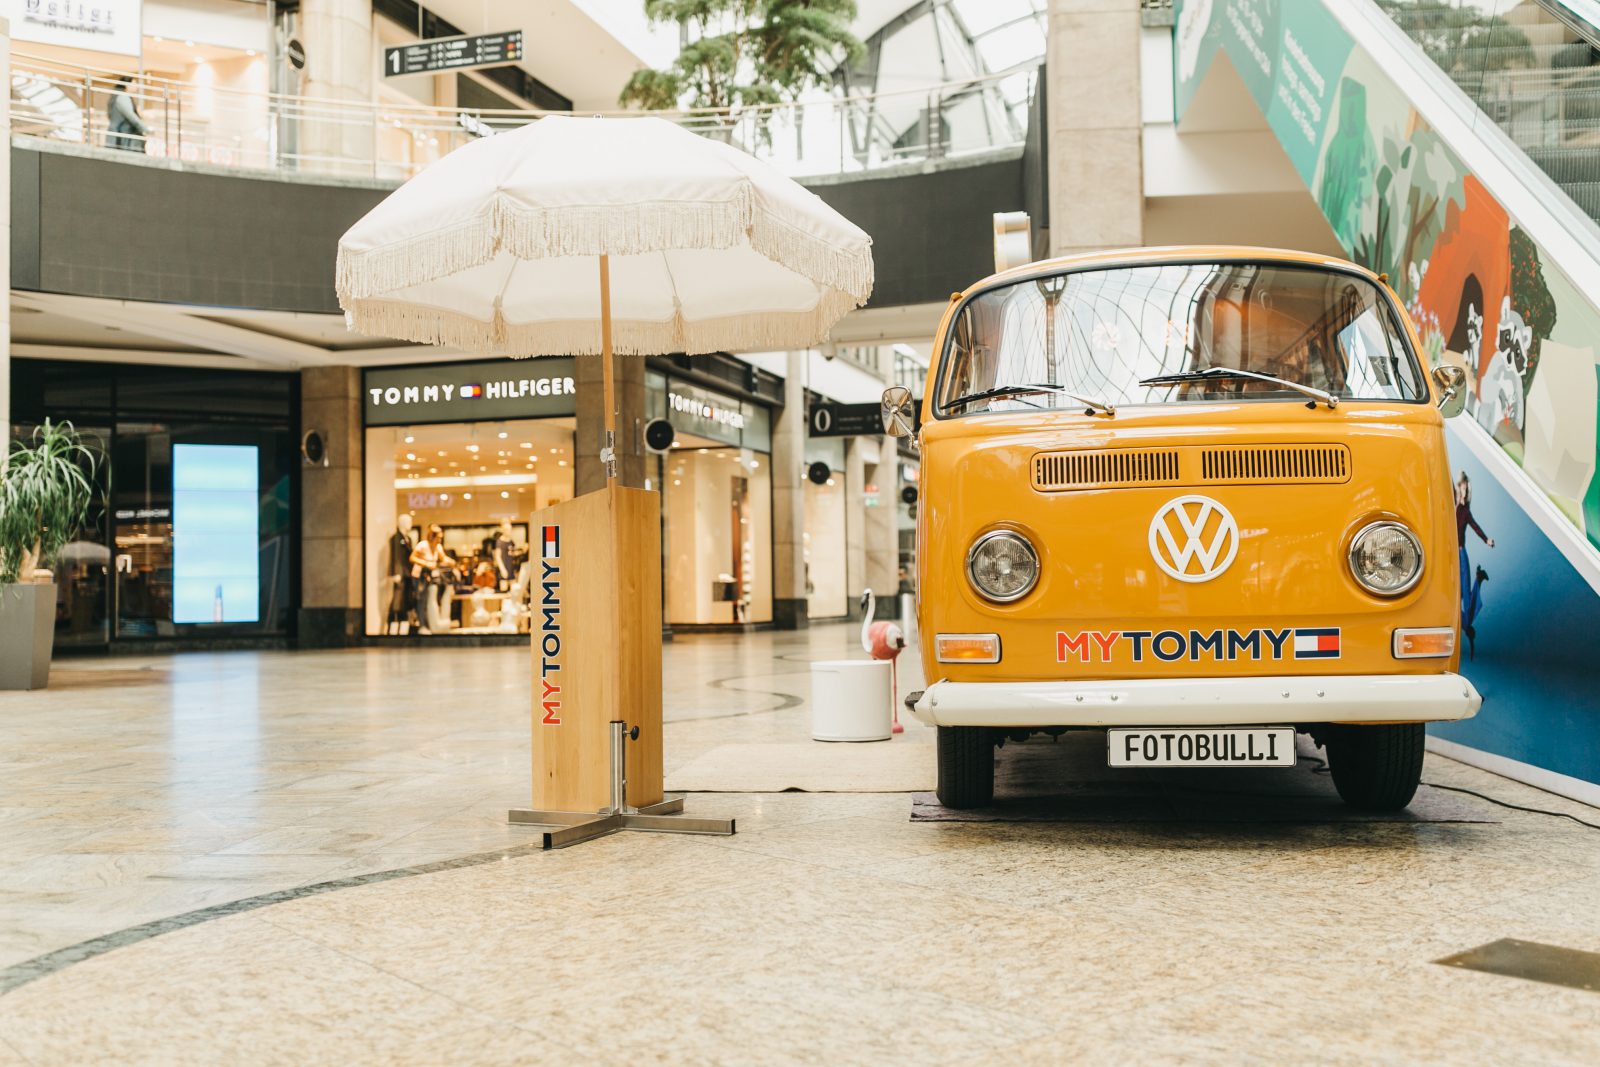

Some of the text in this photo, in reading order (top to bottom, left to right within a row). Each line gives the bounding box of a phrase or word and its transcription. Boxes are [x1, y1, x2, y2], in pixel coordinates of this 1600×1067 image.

[388, 49, 400, 74] 1
[369, 377, 576, 405] TOMMY HILFIGER
[542, 560, 561, 725] MYTOMMY
[1056, 628, 1292, 663] MYTOMMY
[1124, 733, 1280, 761] FOTOBULLI
